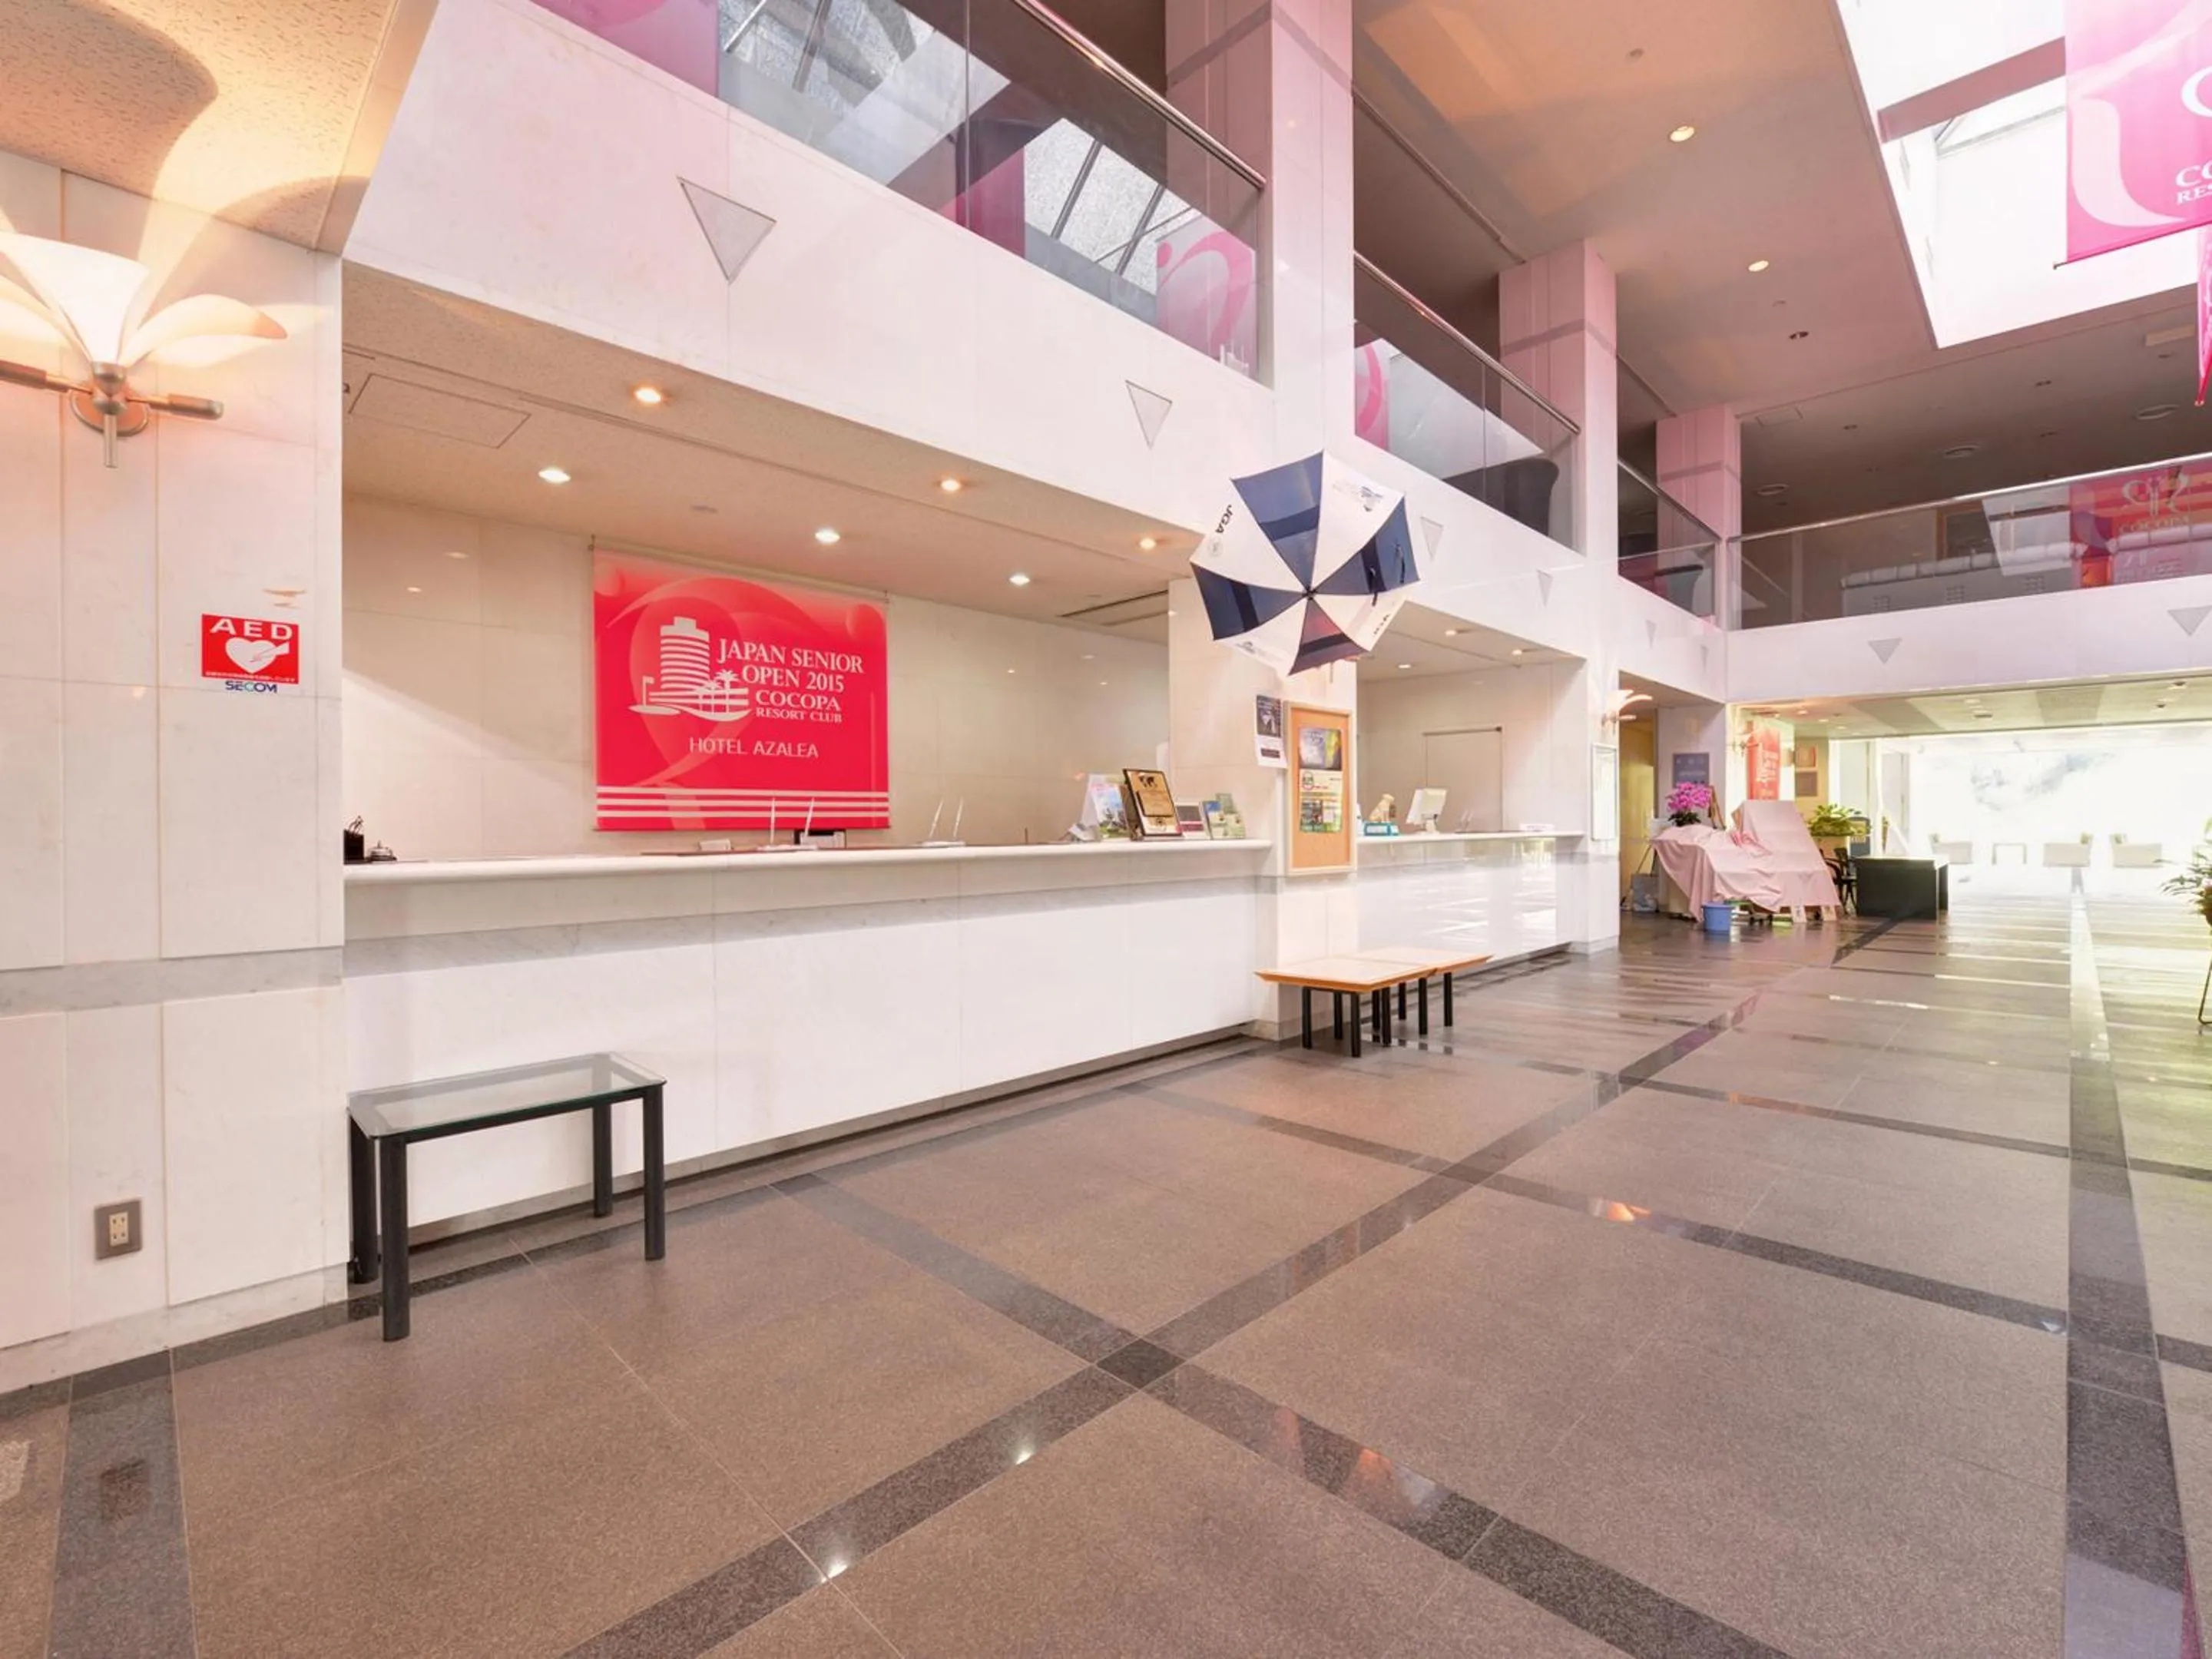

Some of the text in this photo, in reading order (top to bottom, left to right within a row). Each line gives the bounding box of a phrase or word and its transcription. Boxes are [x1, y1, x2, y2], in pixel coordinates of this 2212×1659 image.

[2177, 184, 2212, 205] RE
[1215, 504, 1233, 533] JGA
[210, 618, 293, 641] AED
[717, 638, 864, 674] JAPAN SENIOR
[225, 680, 277, 693] SECOM
[742, 664, 844, 693] OPEN 2015
[756, 690, 841, 711] COCOPA
[756, 707, 843, 724] RESORT CLUB
[690, 737, 819, 758] HOTEL AZALEA
